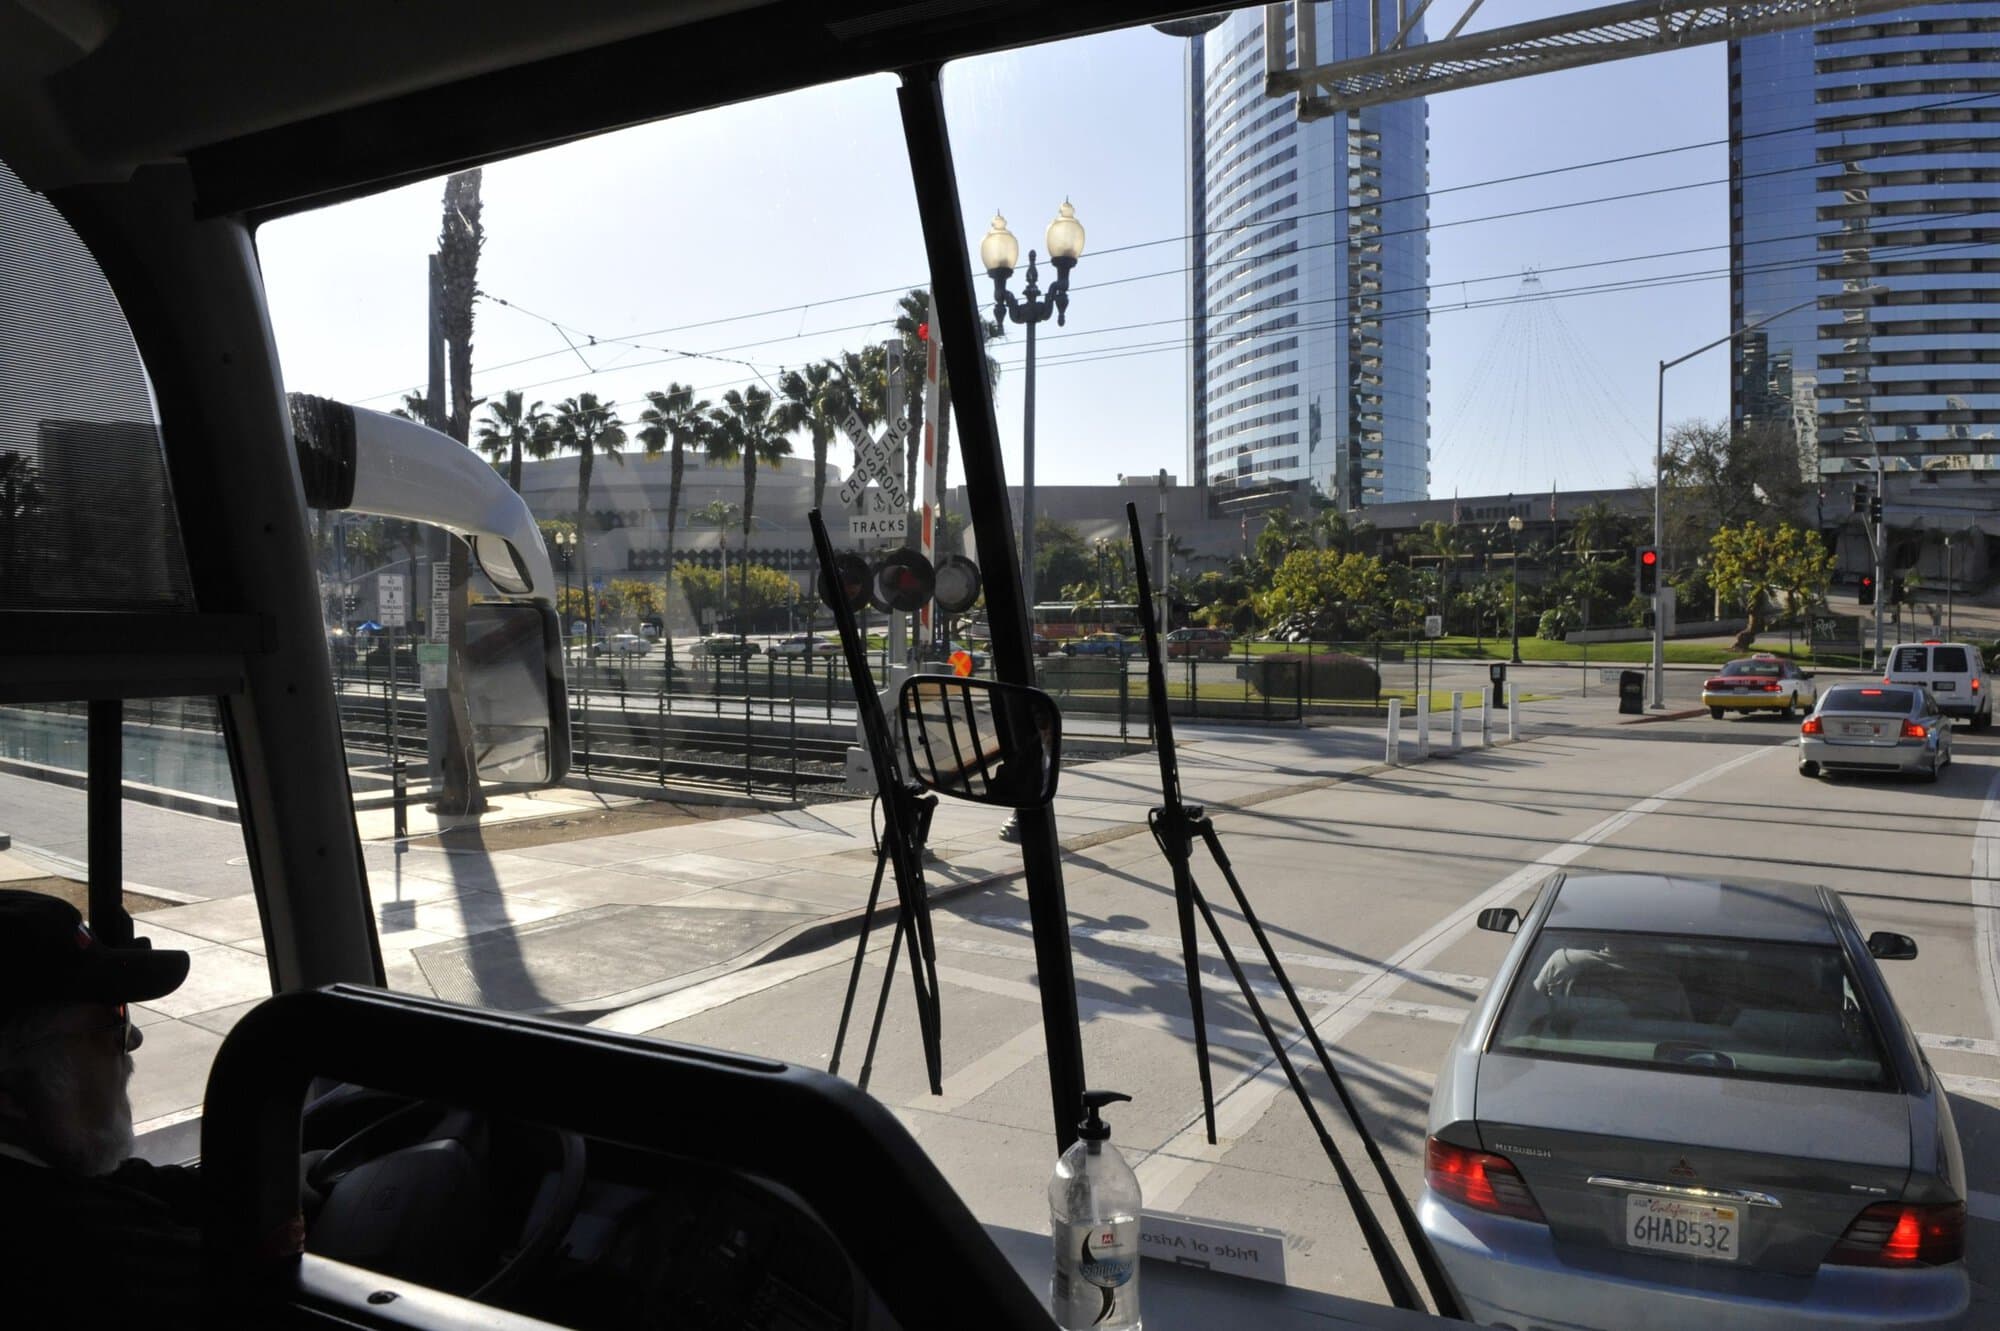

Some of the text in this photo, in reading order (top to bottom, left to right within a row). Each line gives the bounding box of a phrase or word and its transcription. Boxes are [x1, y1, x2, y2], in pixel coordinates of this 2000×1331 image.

[840, 417, 907, 504] CROSSING
[852, 519, 905, 534] TRACKS
[1633, 1215, 1730, 1252] 6HAB532
